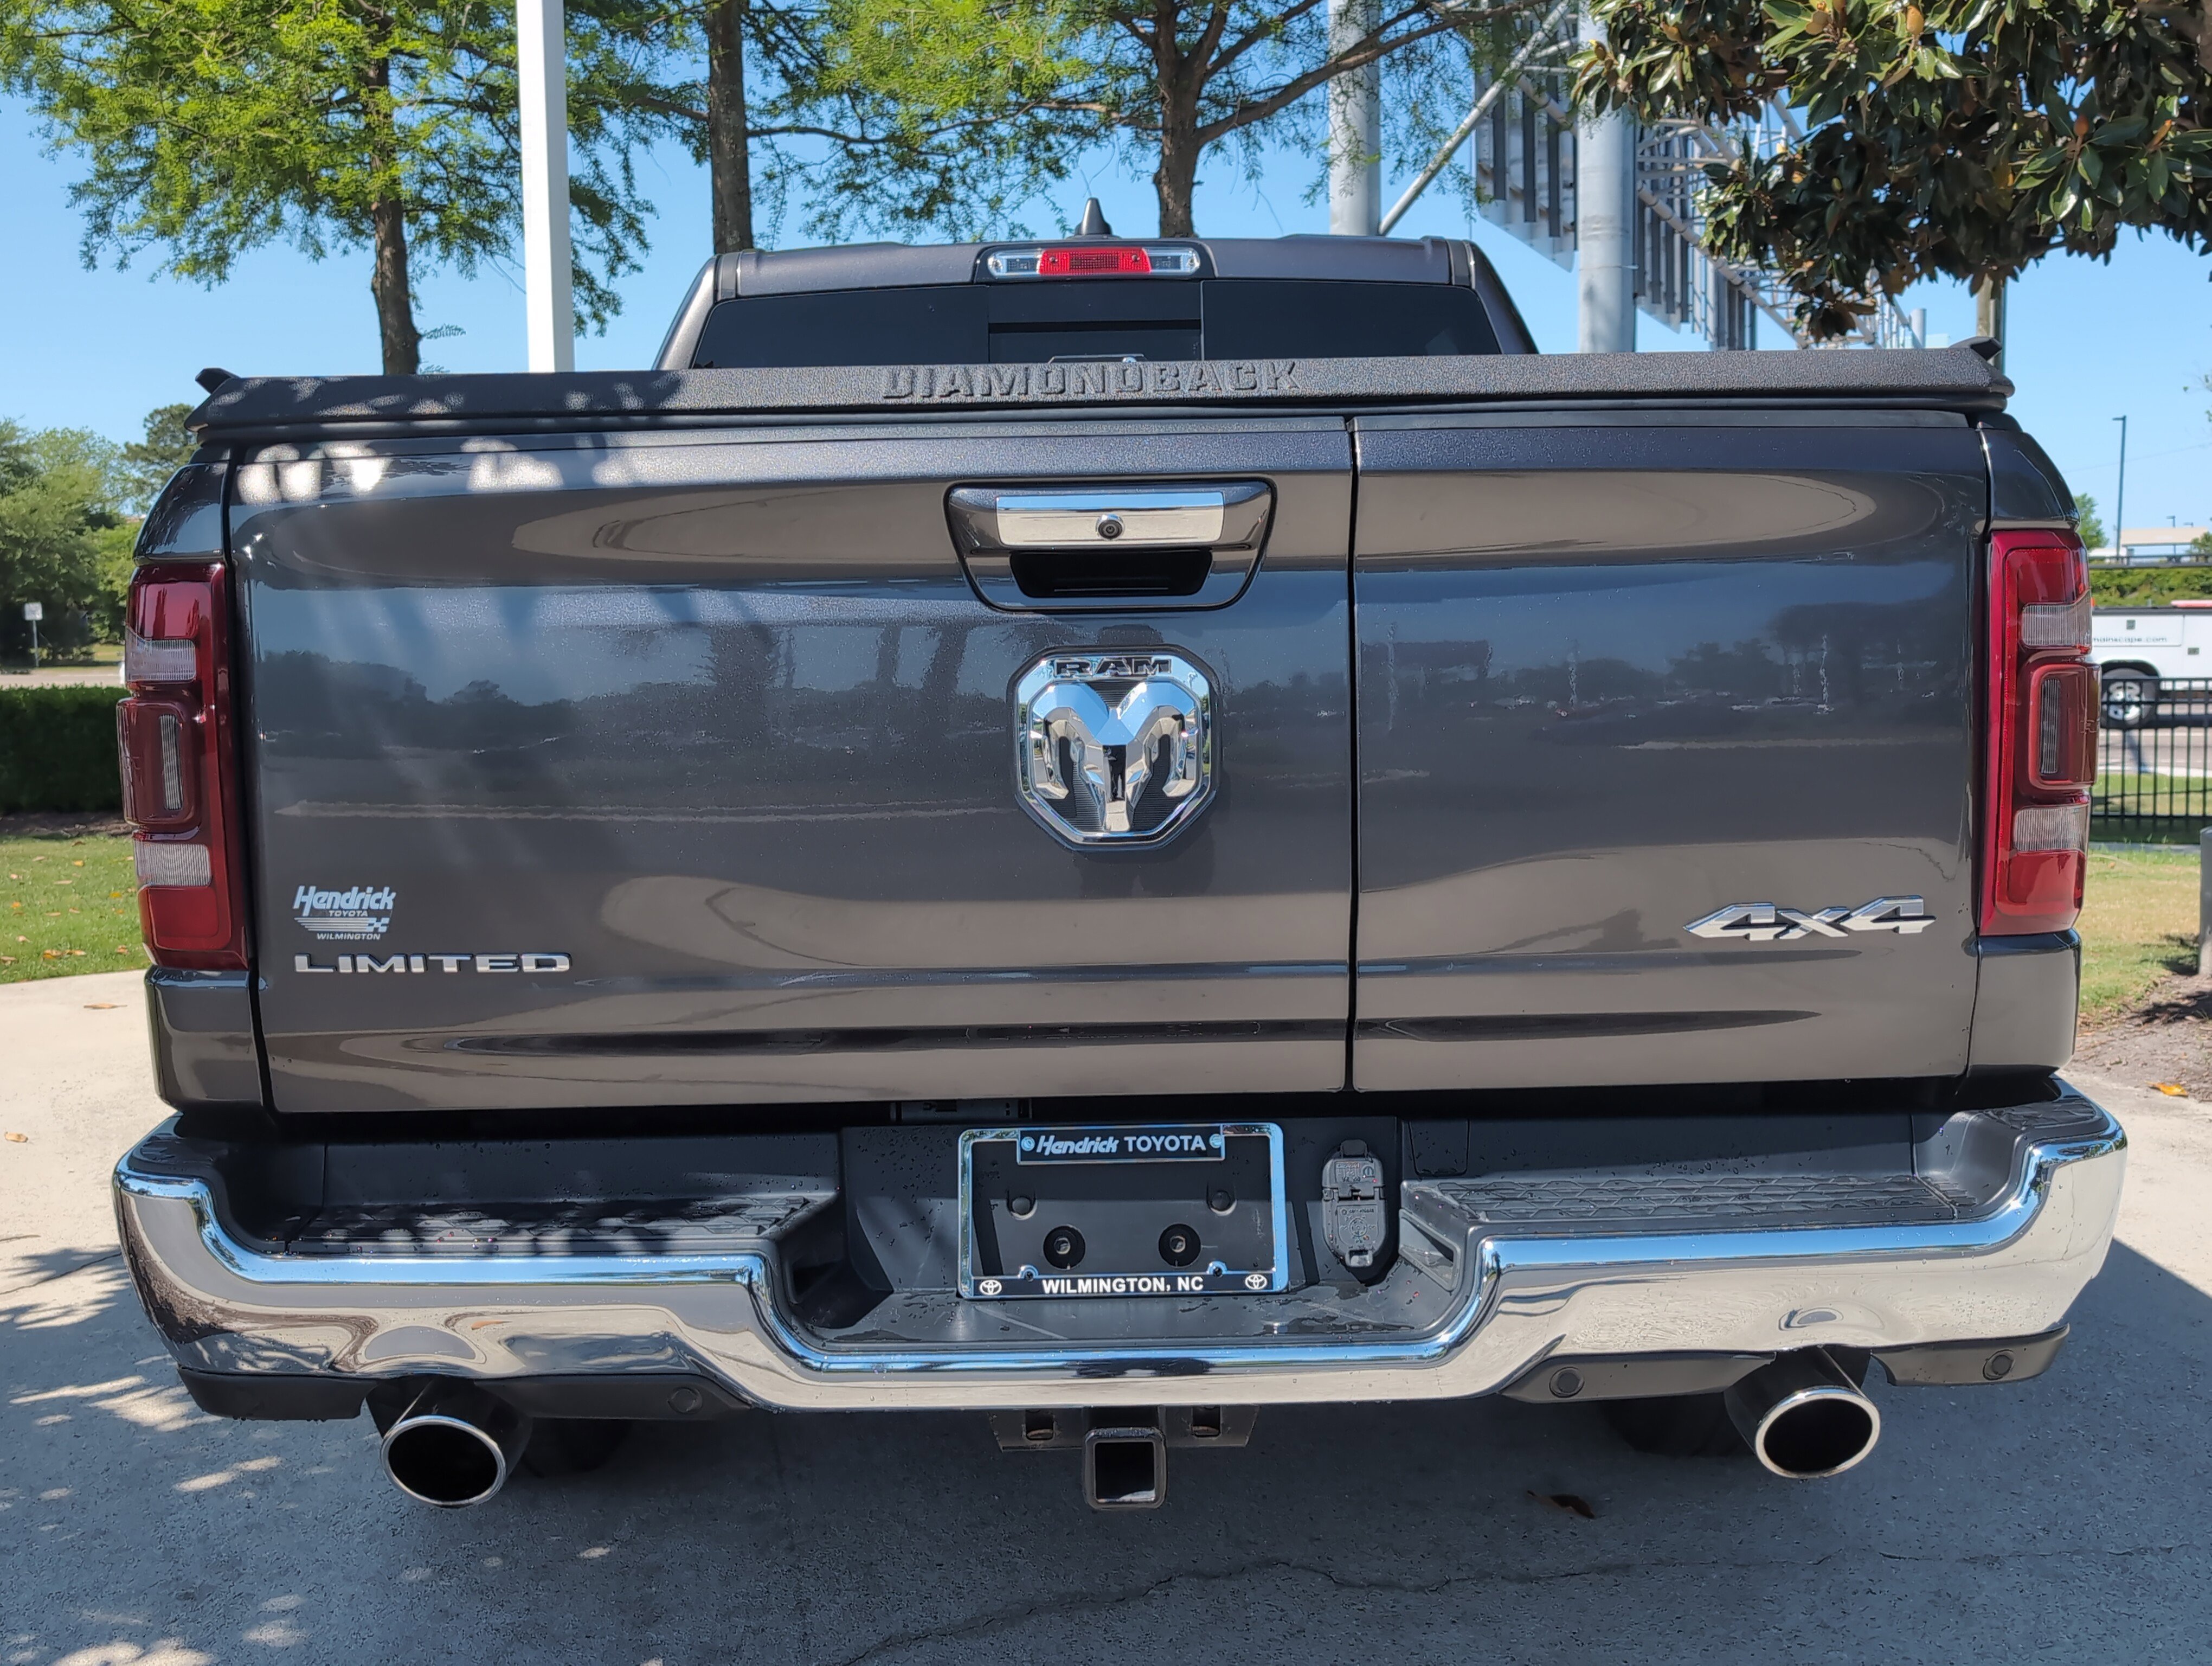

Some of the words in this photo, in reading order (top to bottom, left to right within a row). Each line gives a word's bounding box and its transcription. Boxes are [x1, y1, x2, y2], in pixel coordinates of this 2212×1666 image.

[882, 360, 1301, 399] DIAMONDBACK
[1053, 657, 1172, 677] RAM
[293, 885, 396, 917] Hendrick
[294, 953, 573, 973] LIMITED
[1036, 1135, 1119, 1156] Hendrick
[1124, 1133, 1206, 1152] TOYOTA
[1041, 1277, 1171, 1294] WILMINGTON,
[1177, 1276, 1204, 1291] NC
